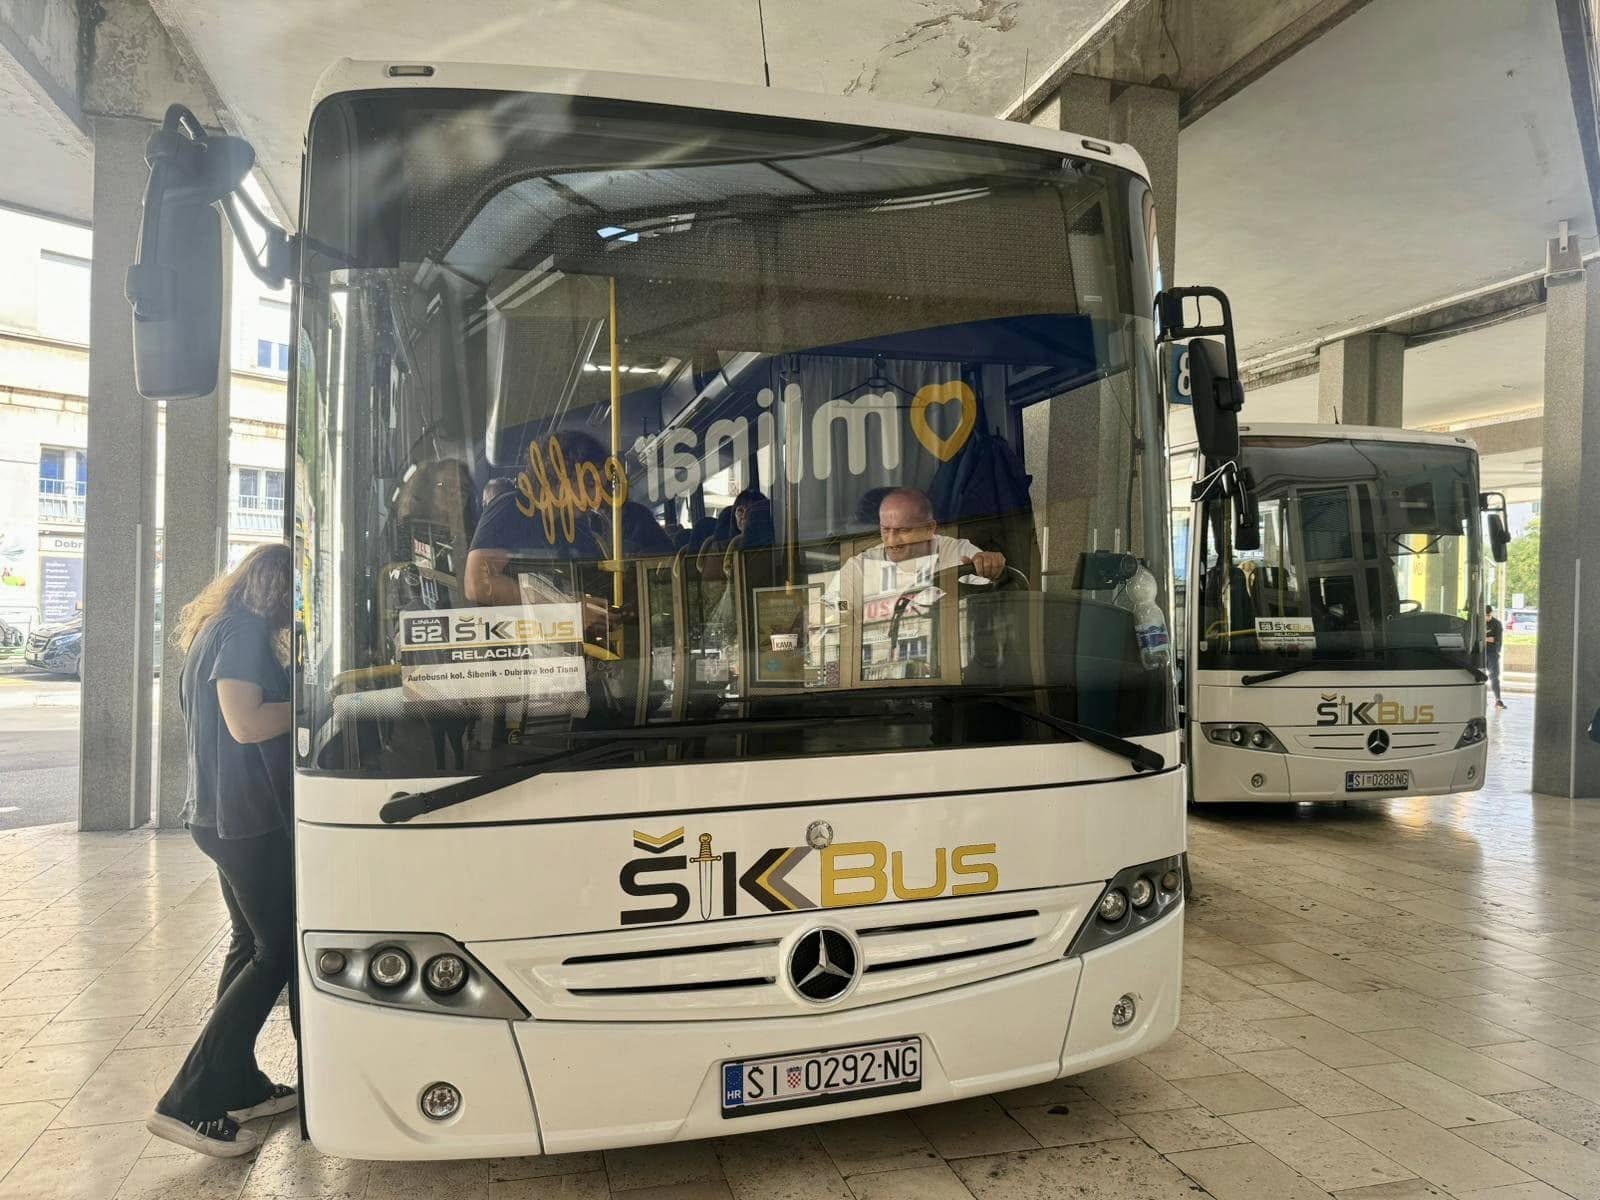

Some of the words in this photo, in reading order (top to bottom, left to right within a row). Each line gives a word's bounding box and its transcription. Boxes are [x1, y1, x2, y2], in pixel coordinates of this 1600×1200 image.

[411, 625, 443, 643] 52
[451, 647, 533, 661] RELACIJA
[407, 673, 448, 682] Autobusni
[449, 671, 466, 680] kol.
[467, 668, 498, 679] Šibenik
[504, 668, 537, 677] Dubrava
[539, 666, 555, 674] kod
[727, 1089, 742, 1100] HR
[747, 1065, 778, 1099] ŠI
